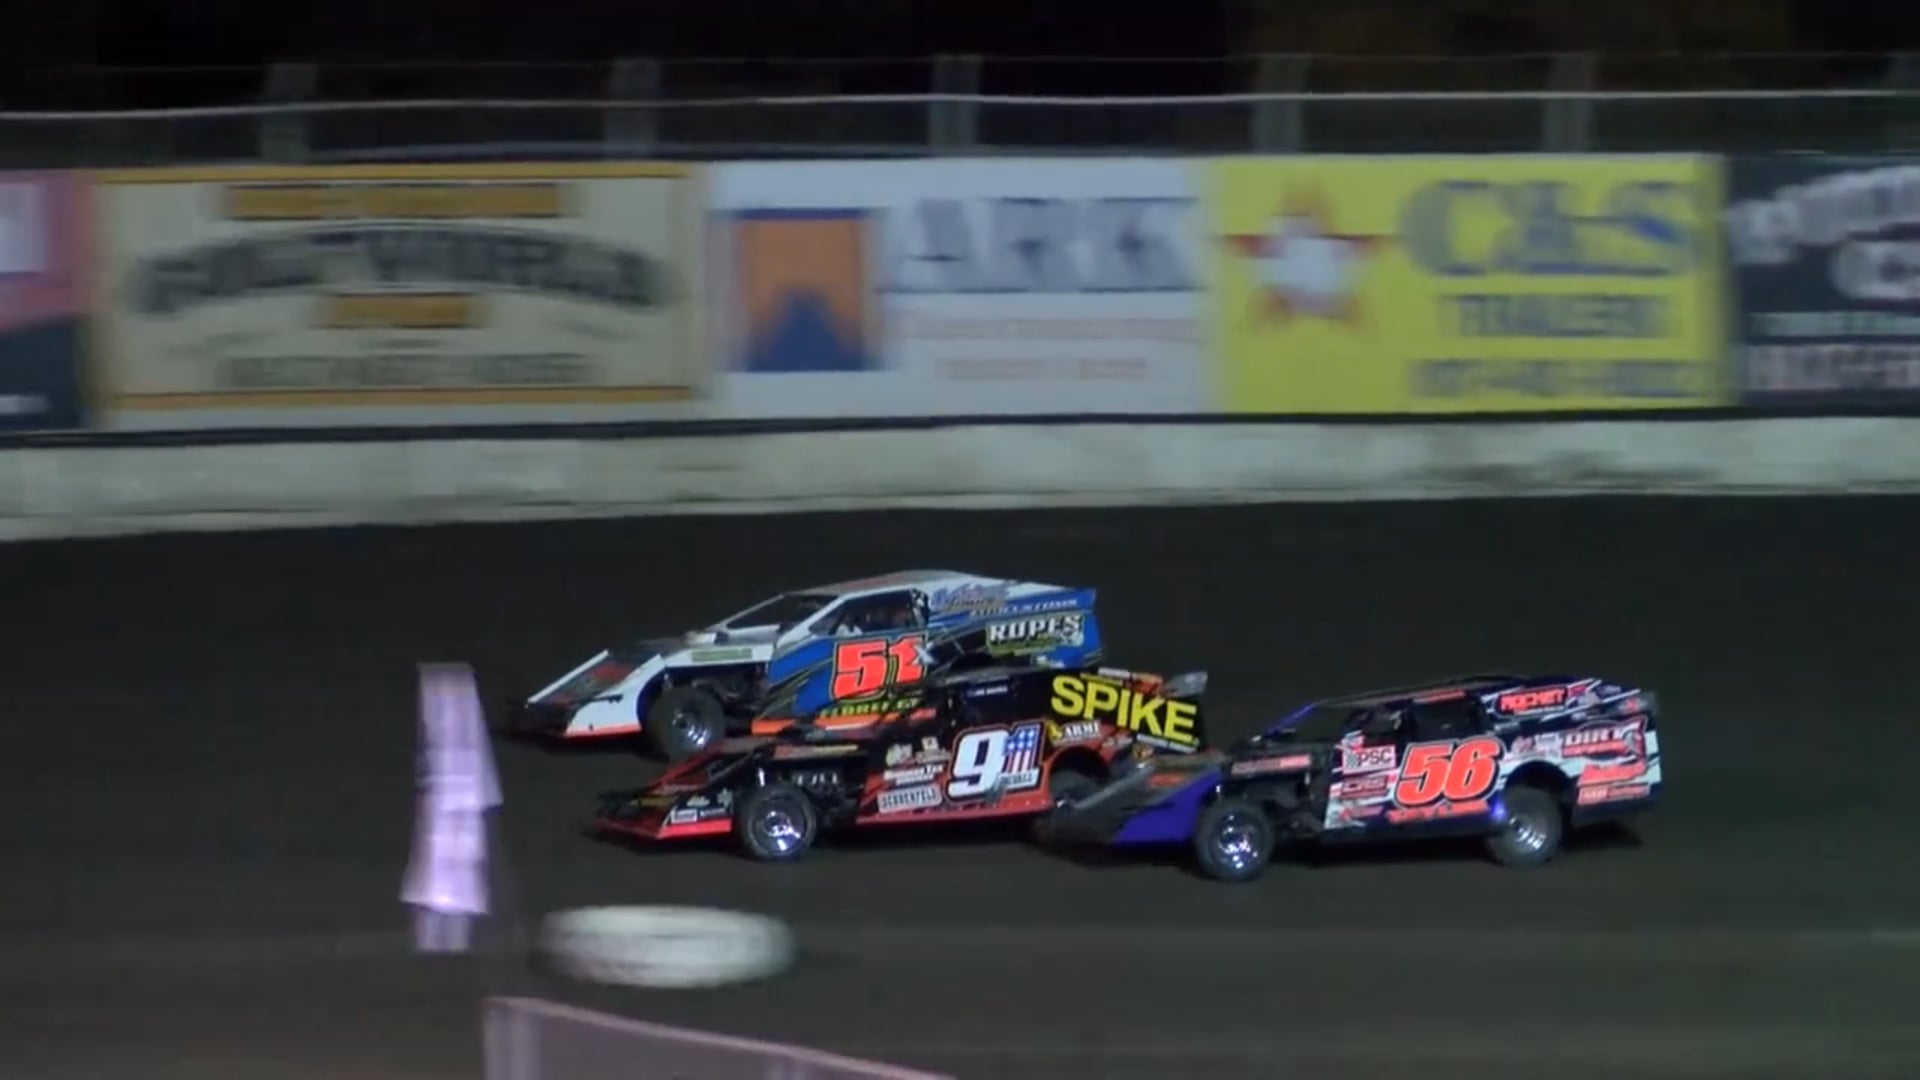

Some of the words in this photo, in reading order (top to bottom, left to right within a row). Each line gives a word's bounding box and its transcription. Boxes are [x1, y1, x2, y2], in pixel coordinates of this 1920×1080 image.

[1051, 675, 1198, 746] SPIKE
[1358, 749, 1392, 767] PSC
[1396, 738, 1500, 807] 56
